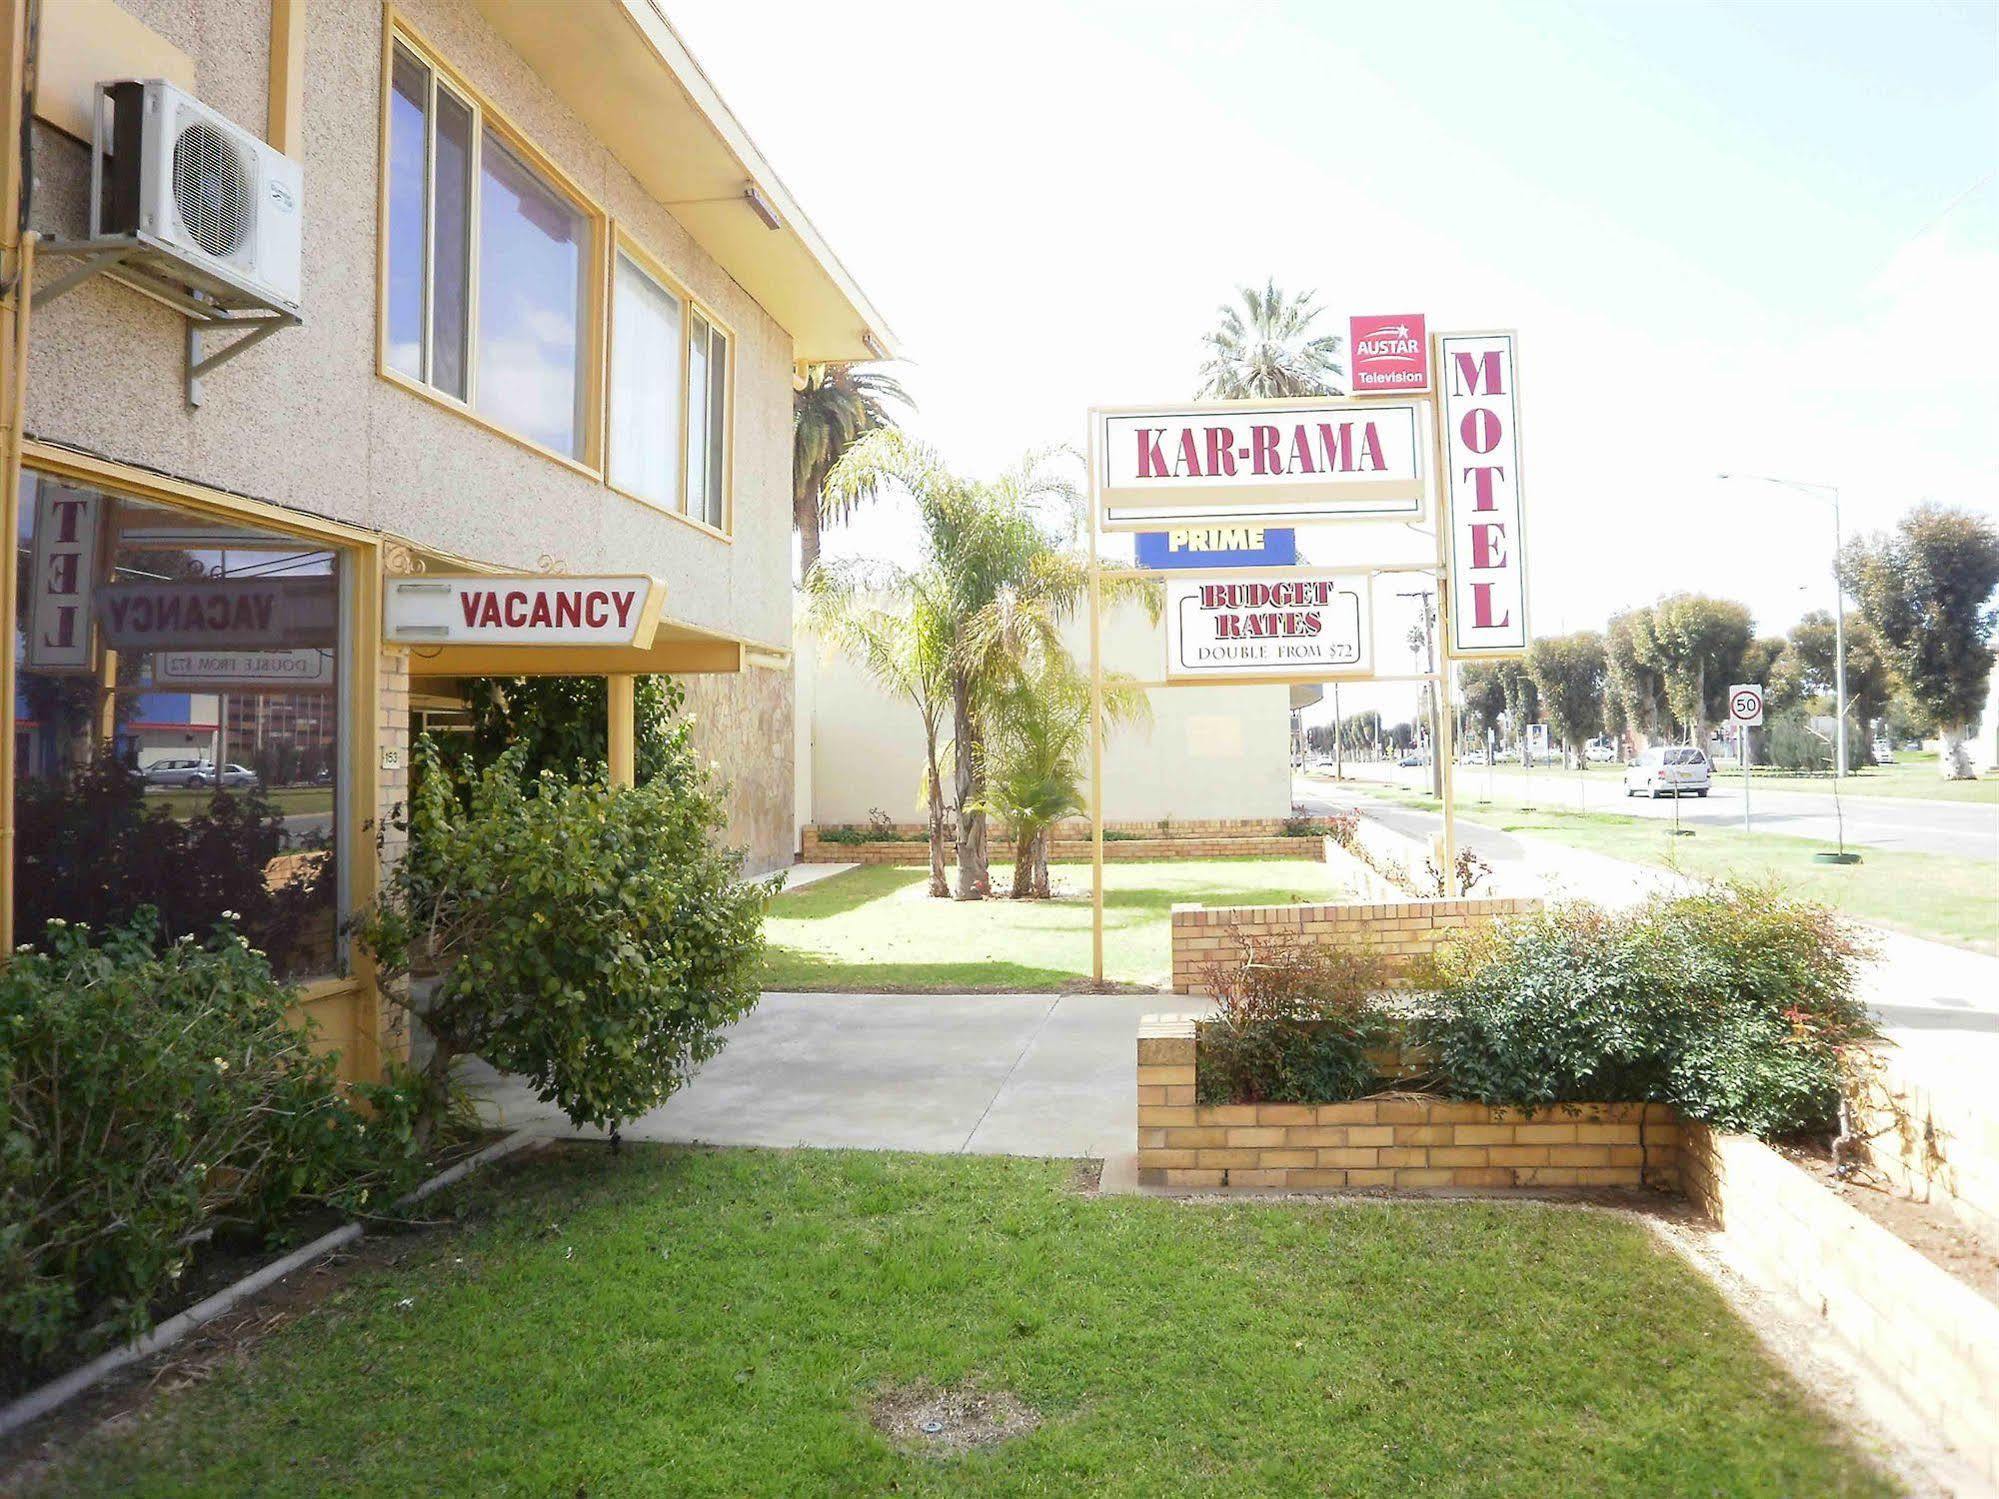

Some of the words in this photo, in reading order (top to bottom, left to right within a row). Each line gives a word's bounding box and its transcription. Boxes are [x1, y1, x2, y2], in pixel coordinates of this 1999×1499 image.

[1357, 339, 1420, 356] AUSTAR
[1358, 369, 1423, 384] Television
[1134, 421, 1388, 478] KAR-RAMA
[1451, 350, 1509, 629] MOTEL
[1168, 527, 1264, 552] PRIME
[1199, 581, 1334, 610] BUDGET
[460, 591, 636, 628] VACANCY
[1215, 611, 1322, 639] RATES
[1199, 645, 1268, 661] DOUBLE
[1278, 643, 1322, 659] FROM
[1329, 643, 1353, 660] $72
[1736, 697, 1756, 713] 50
